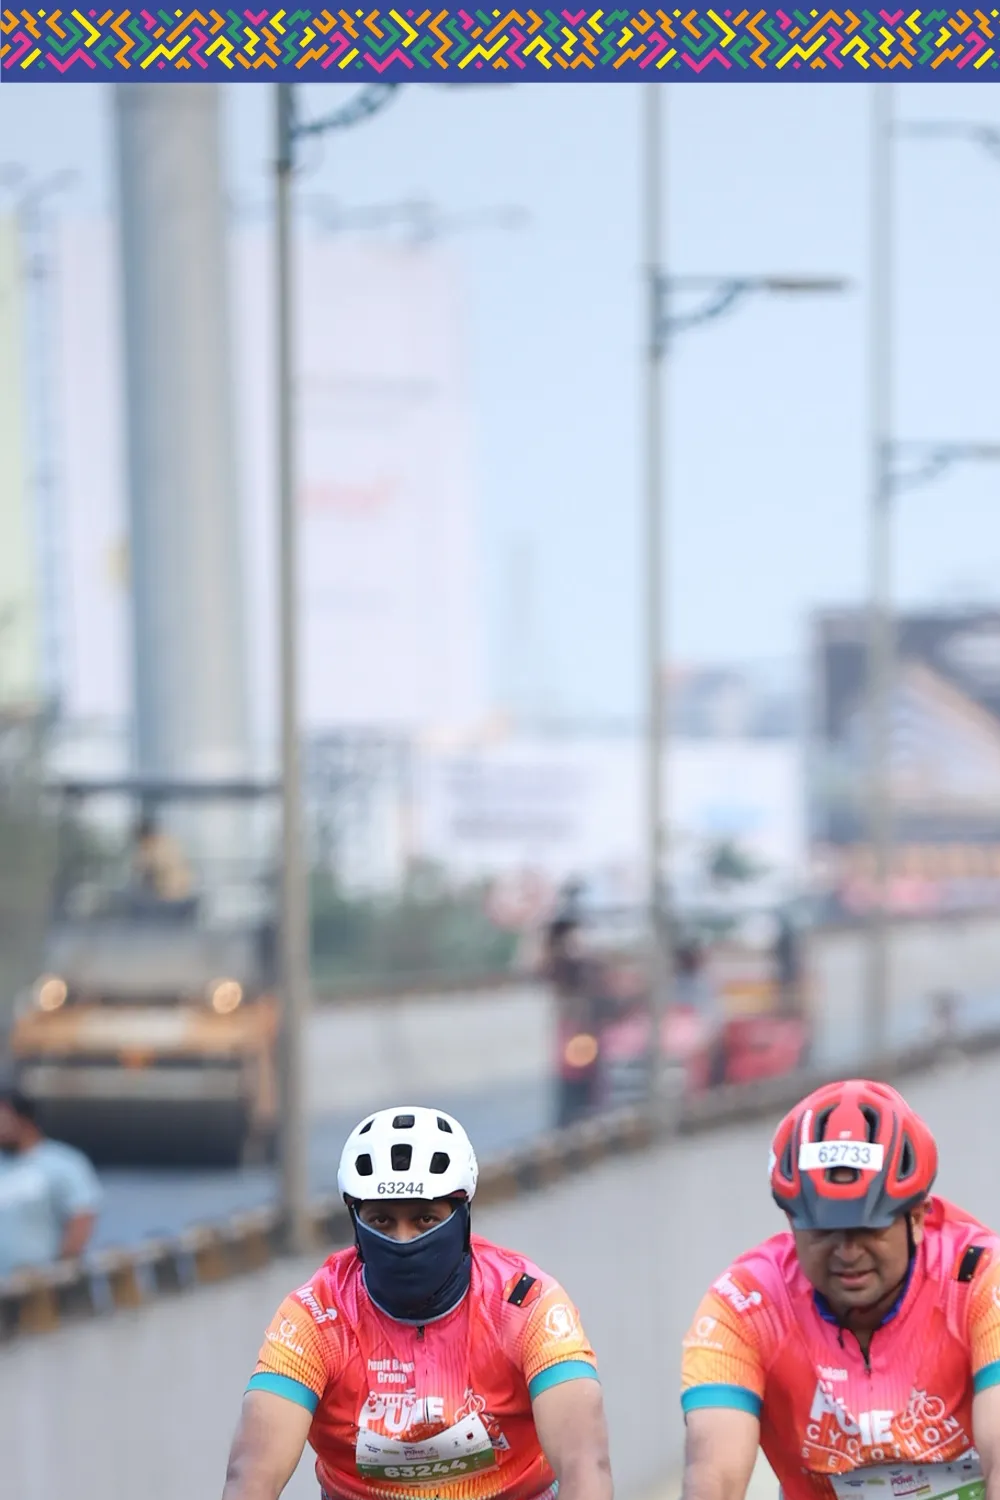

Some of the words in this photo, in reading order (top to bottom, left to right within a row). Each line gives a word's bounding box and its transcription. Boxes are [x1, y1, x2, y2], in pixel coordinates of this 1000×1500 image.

[818, 1146, 872, 1164] 62733
[377, 1181, 424, 1195] 63244
[384, 1459, 468, 1478] 63244
